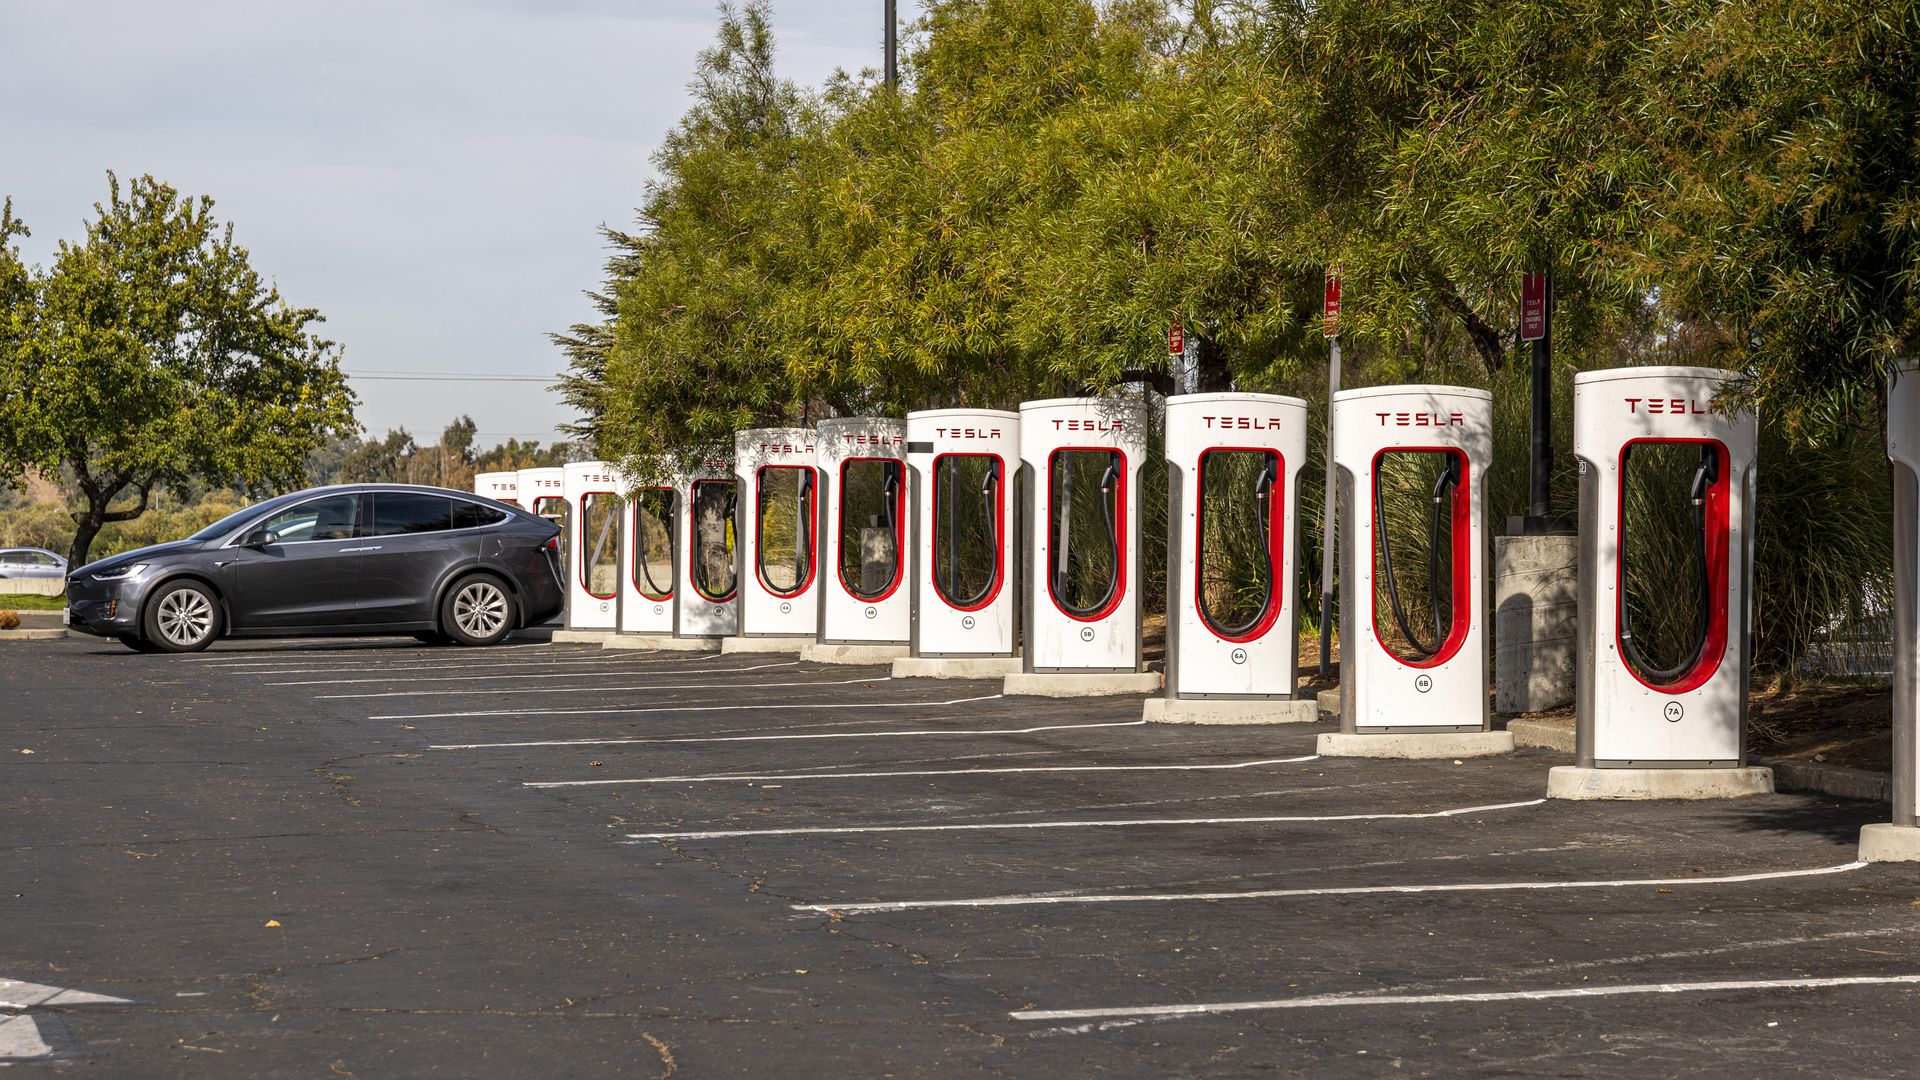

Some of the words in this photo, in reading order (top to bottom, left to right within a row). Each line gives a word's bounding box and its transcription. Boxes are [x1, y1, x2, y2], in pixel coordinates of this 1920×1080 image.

[1051, 419, 1124, 431] TESLA
[1202, 416, 1281, 430] TESLA
[1375, 412, 1464, 427] TESLA
[936, 428, 1001, 439] TESLA
[843, 435, 903, 446] TESLA
[759, 444, 814, 454] TESLA
[583, 474, 616, 483] TESL
[492, 483, 516, 491] TES
[1668, 708, 1680, 716] 7A
